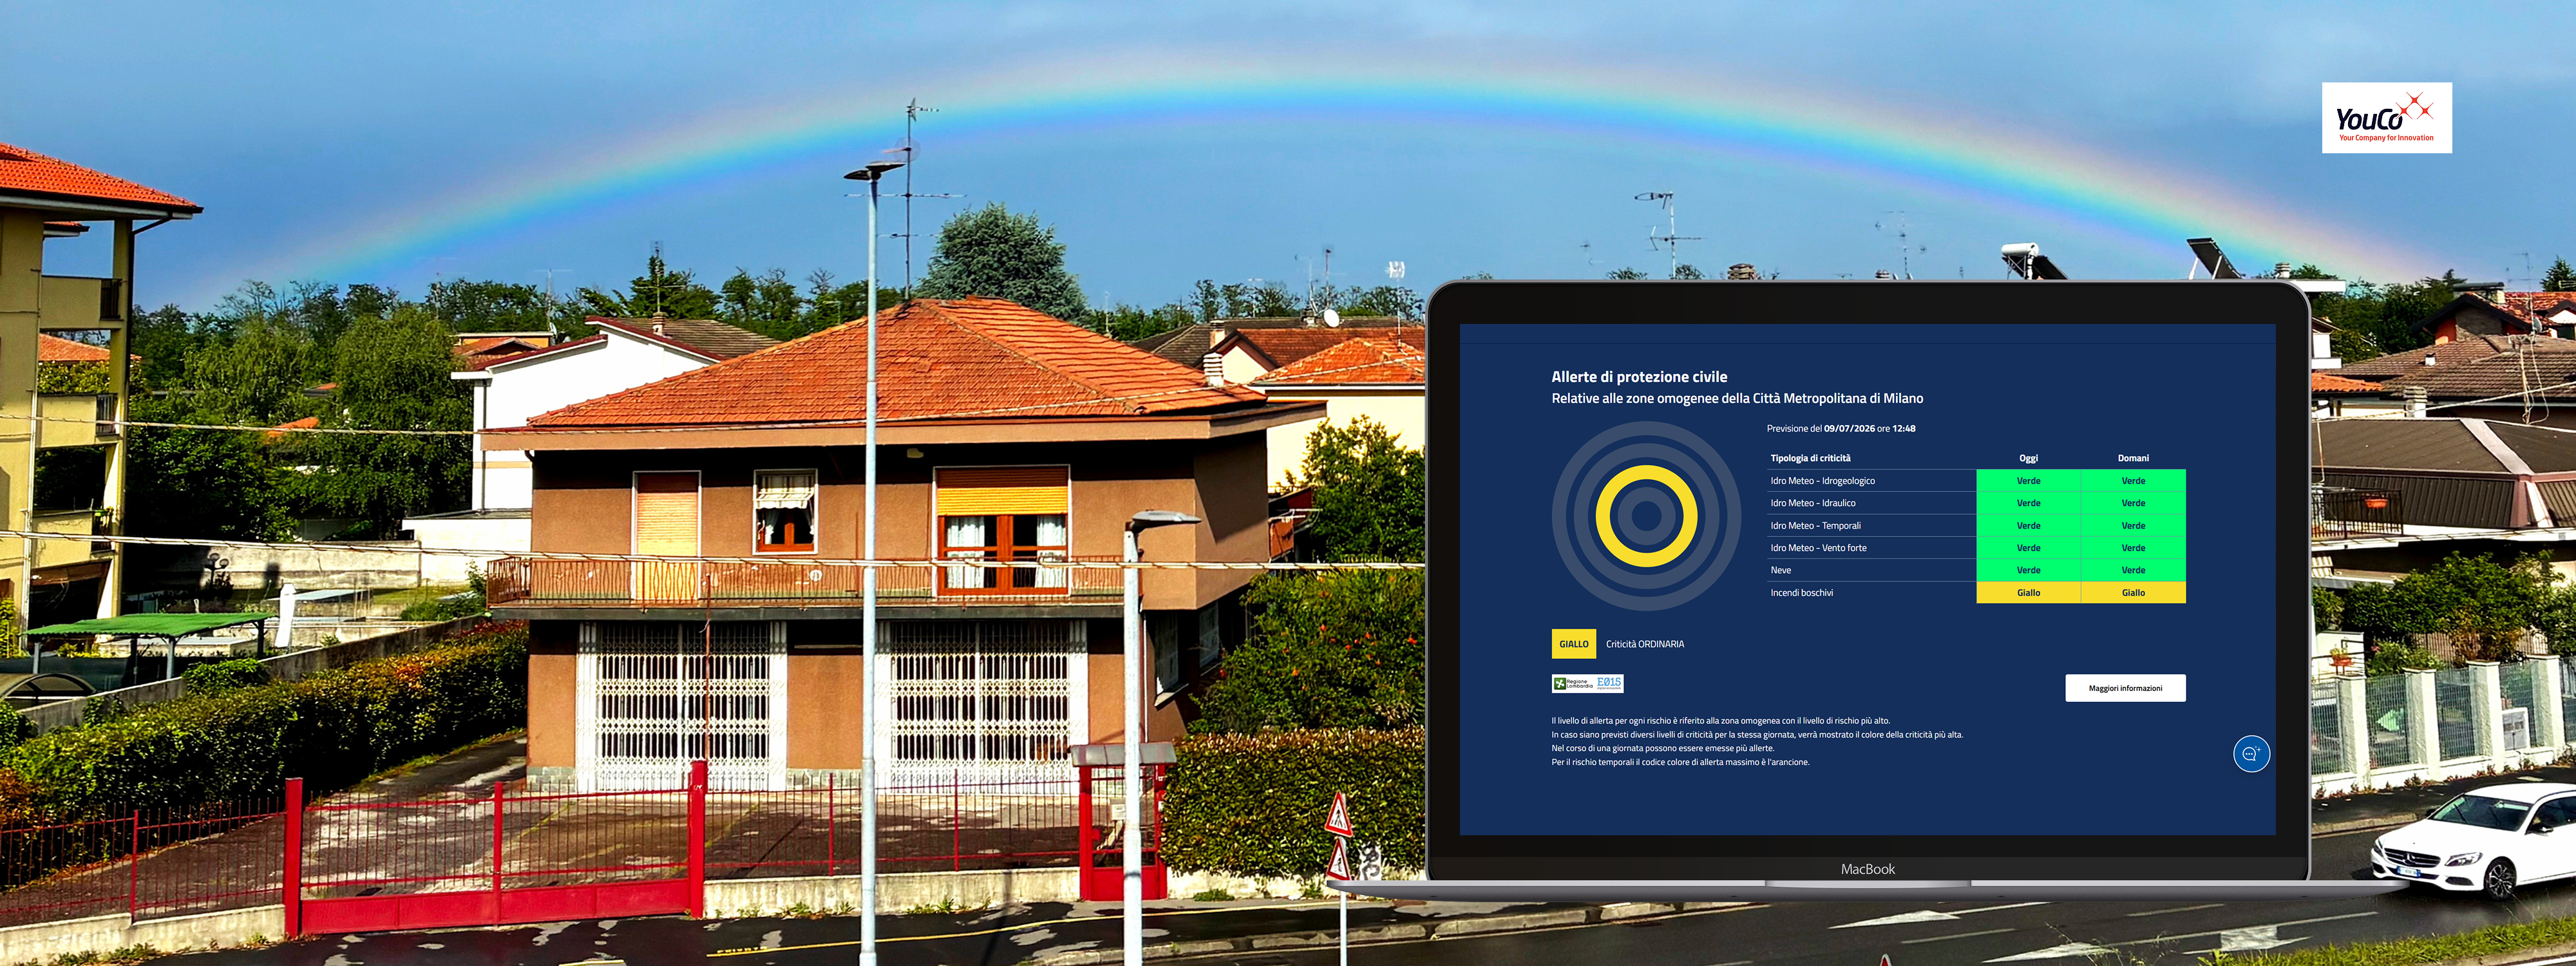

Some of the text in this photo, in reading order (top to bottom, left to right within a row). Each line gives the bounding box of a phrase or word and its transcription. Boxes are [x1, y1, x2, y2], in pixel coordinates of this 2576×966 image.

[1551, 370, 1728, 386] Allerte di protezione civile
[1552, 392, 1924, 407] Relative alle zone omogenee della Città Metropolitana di Milano
[1767, 424, 1809, 433] Previsione
[1810, 424, 1823, 433] del
[1824, 424, 1876, 433] 09/07/2026
[1892, 424, 1917, 433] 12:48
[1770, 453, 1852, 464] Tipologia di criticità
[2019, 453, 2039, 464] Oggi
[2117, 453, 2150, 462] Domani
[1771, 476, 1787, 485] Idro
[1788, 477, 1815, 485] Meteo
[1822, 476, 1876, 487] Idrogeologico
[2016, 477, 2041, 485] Verde
[2121, 477, 2146, 485] Verde
[1771, 498, 1787, 507] Idro
[1788, 498, 1815, 507] Meteo
[1822, 498, 1856, 507] Idraulico
[2016, 498, 2041, 507] Verde
[2121, 498, 2146, 507] Verde
[1771, 521, 1787, 530] Idro
[1788, 521, 1815, 530] Meteo
[1821, 521, 1861, 532] Temporali
[1771, 544, 1787, 552] Idro
[1788, 544, 1815, 552] Meteo
[1821, 544, 1846, 552] Vento
[1847, 543, 1868, 552] forte
[2016, 544, 2041, 552] Verde
[2121, 544, 2146, 552] Verde
[1771, 565, 1792, 574] Neve
[1771, 588, 1833, 597] Incendi boschivi
[2017, 589, 2041, 597] Giallo
[2122, 589, 2146, 597] Giallo
[1606, 639, 1685, 649] Criticità ORDINARIA
[2088, 685, 2119, 694] Maggiori
[1551, 716, 1557, 724] Il
[1557, 716, 1580, 724] livello
[1580, 716, 1588, 724] di
[1589, 716, 1614, 724] allerta
[1615, 718, 1628, 726] per
[1629, 717, 1645, 726] ogni
[1647, 716, 1672, 724] rischio
[1672, 716, 1678, 724] è
[1679, 716, 1705, 724] riferito
[1706, 716, 1720, 724] alla
[1741, 718, 1781, 726] omogenea
[1797, 716, 1801, 724] il
[1803, 716, 1825, 724] livello
[1826, 716, 1833, 724] di
[1834, 716, 1860, 724] rischio
[1861, 716, 1873, 726] più
[1873, 716, 1891, 724] alto.
[1601, 730, 1629, 741] previsti
[1630, 730, 1655, 739] diversi
[1656, 730, 1676, 739] livelli
[1676, 730, 1684, 739] di
[1685, 730, 1714, 739] criticità
[1714, 732, 1728, 741] per
[1728, 730, 1736, 739] la
[1763, 731, 1797, 741] giornata,
[1797, 730, 1818, 739] verrà
[1861, 730, 1884, 739] colore
[1886, 730, 1904, 739] della
[1905, 730, 1933, 739] criticità
[1934, 730, 1946, 741] più
[1947, 730, 1964, 739] alta.
[1551, 744, 1564, 752] Nel
[1587, 744, 1595, 752] di
[1612, 744, 1644, 754] giornata
[1645, 746, 1678, 754] possono
[1736, 744, 1748, 754] più
[1748, 744, 1775, 752] allerte.
[1598, 758, 1634, 768] temporali
[1841, 863, 1896, 875] MacBook
